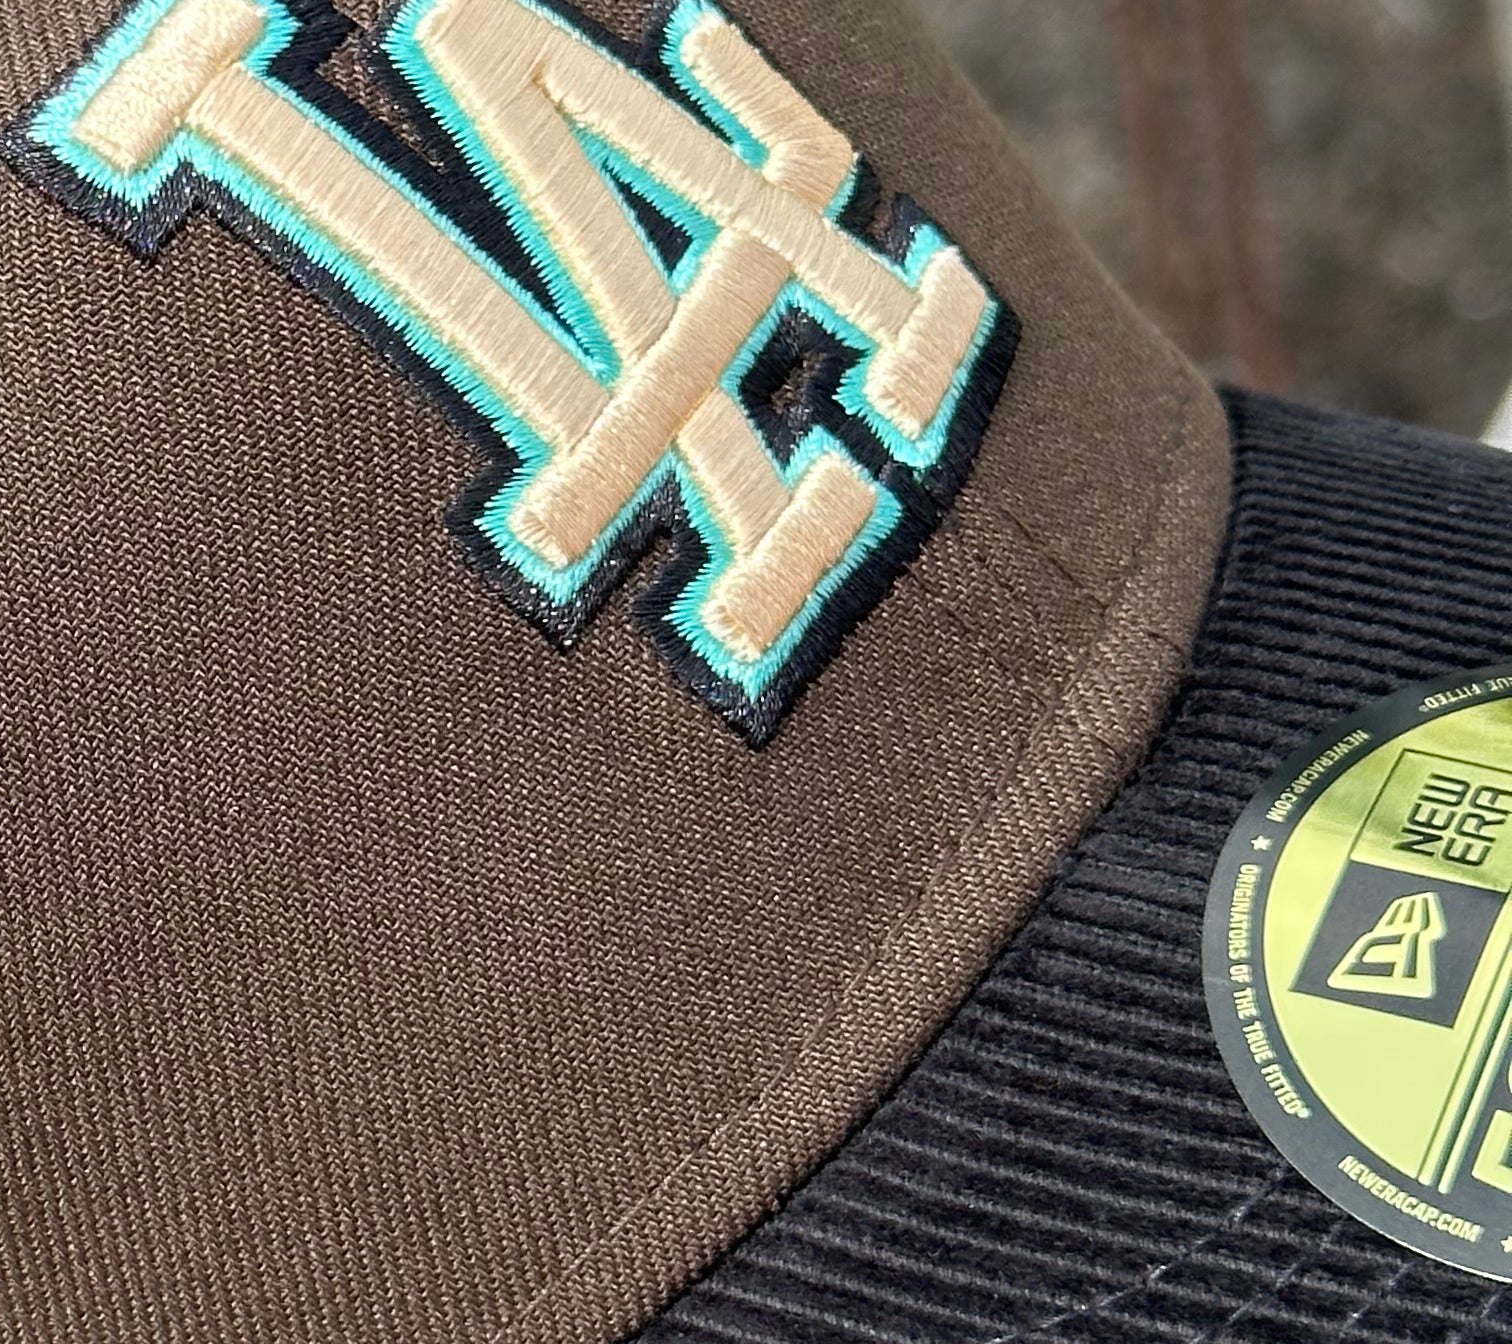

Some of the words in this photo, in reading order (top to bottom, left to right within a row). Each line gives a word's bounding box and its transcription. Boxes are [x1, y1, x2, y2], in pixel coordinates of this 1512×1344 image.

[1266, 729, 1370, 822] NEWERACAP.COM
[1392, 771, 1472, 857] NEW
[1441, 785, 1512, 867] ERA
[1228, 863, 1260, 960] ORIGINATORS
[1229, 963, 1252, 984] OF
[1233, 986, 1259, 1020] THE
[1242, 1020, 1276, 1064] TRUE
[1337, 1155, 1484, 1243] NEWERACAP.COM
